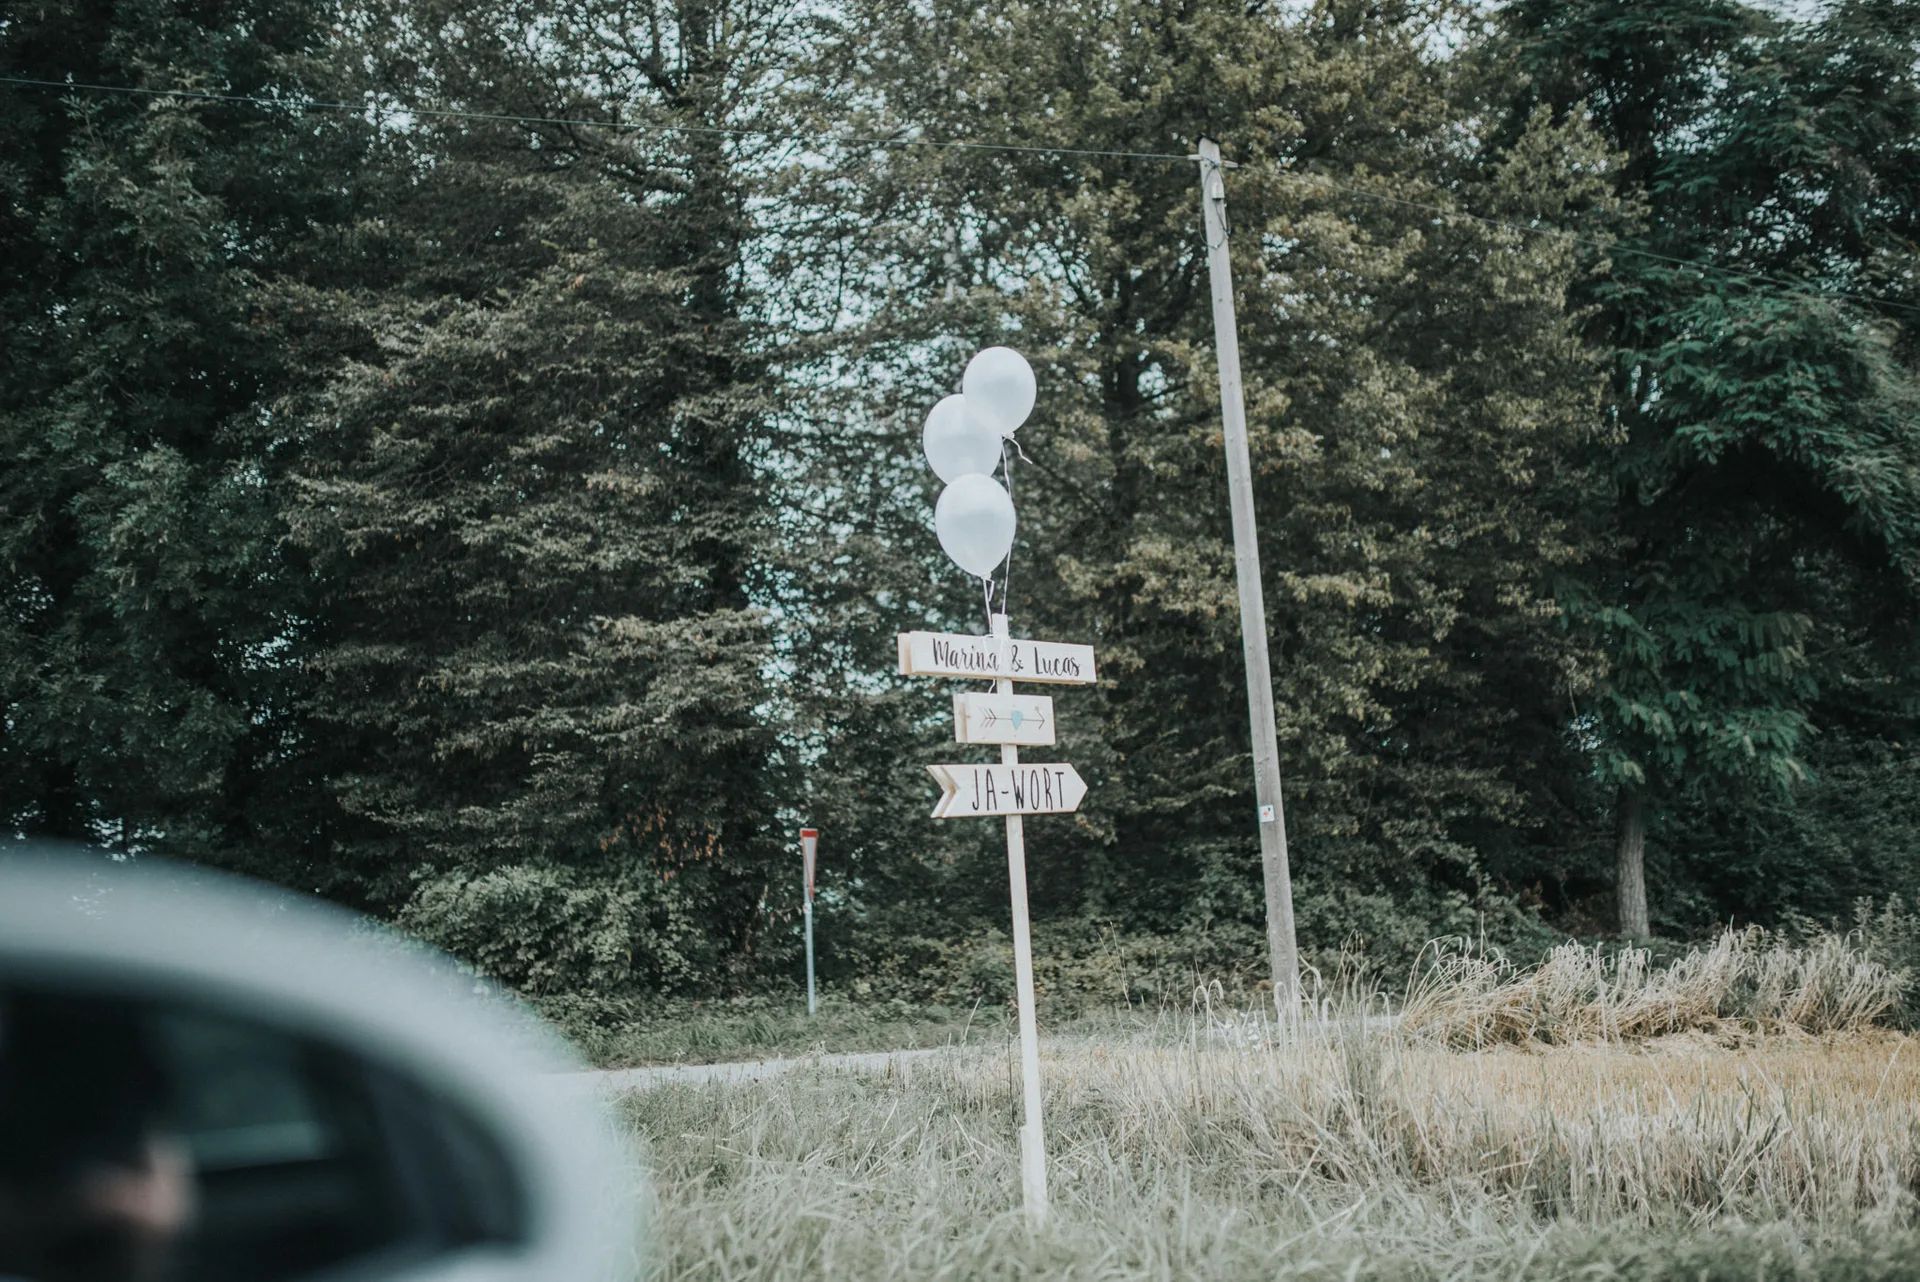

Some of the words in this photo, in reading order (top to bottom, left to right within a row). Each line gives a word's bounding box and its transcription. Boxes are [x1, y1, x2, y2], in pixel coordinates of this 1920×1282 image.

[932, 638, 1000, 672] Marina
[1010, 644, 1024, 673] &
[1034, 646, 1081, 677] Lucas
[972, 767, 1065, 811] JA-WORT
